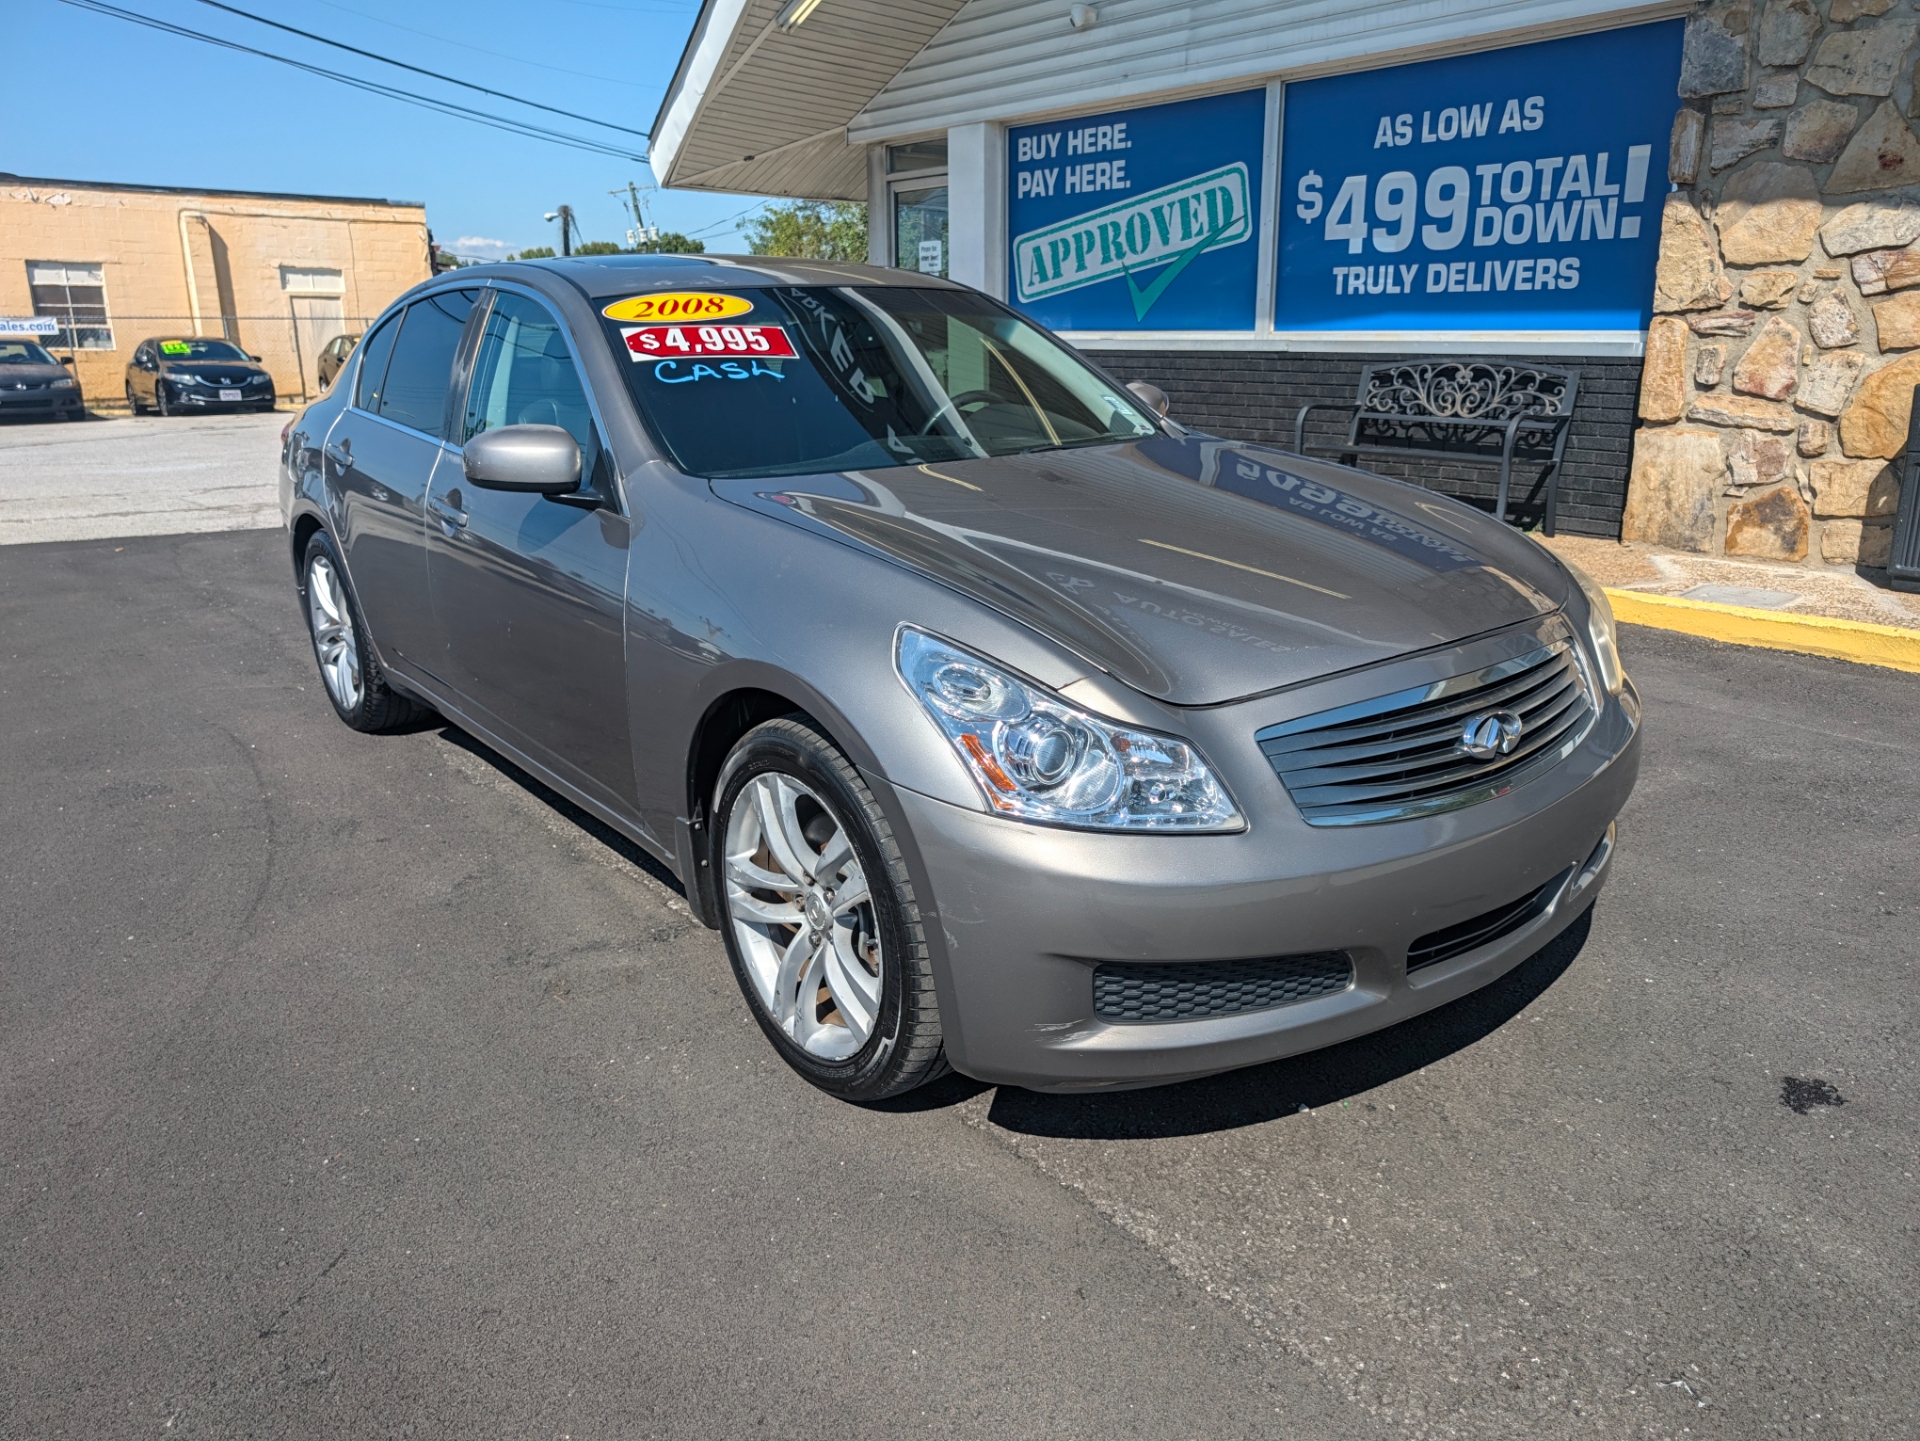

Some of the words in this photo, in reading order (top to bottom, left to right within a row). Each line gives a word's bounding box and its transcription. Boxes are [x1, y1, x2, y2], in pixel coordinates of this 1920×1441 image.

[1018, 132, 1062, 162] BUY
[1067, 122, 1132, 156] HERE.
[1373, 113, 1413, 149] AS
[1421, 102, 1493, 144] LOW
[1498, 96, 1545, 134] AS
[1017, 168, 1059, 199] PAY
[1065, 159, 1131, 194] HERE.
[1475, 151, 1620, 206] TOTAL
[1296, 165, 1470, 255] $499
[1027, 185, 1235, 288] APPROVED
[1332, 264, 1419, 295] TRULY
[1426, 257, 1581, 293] DELIVERS
[632, 297, 725, 318] 2008
[639, 327, 771, 353] $4,995
